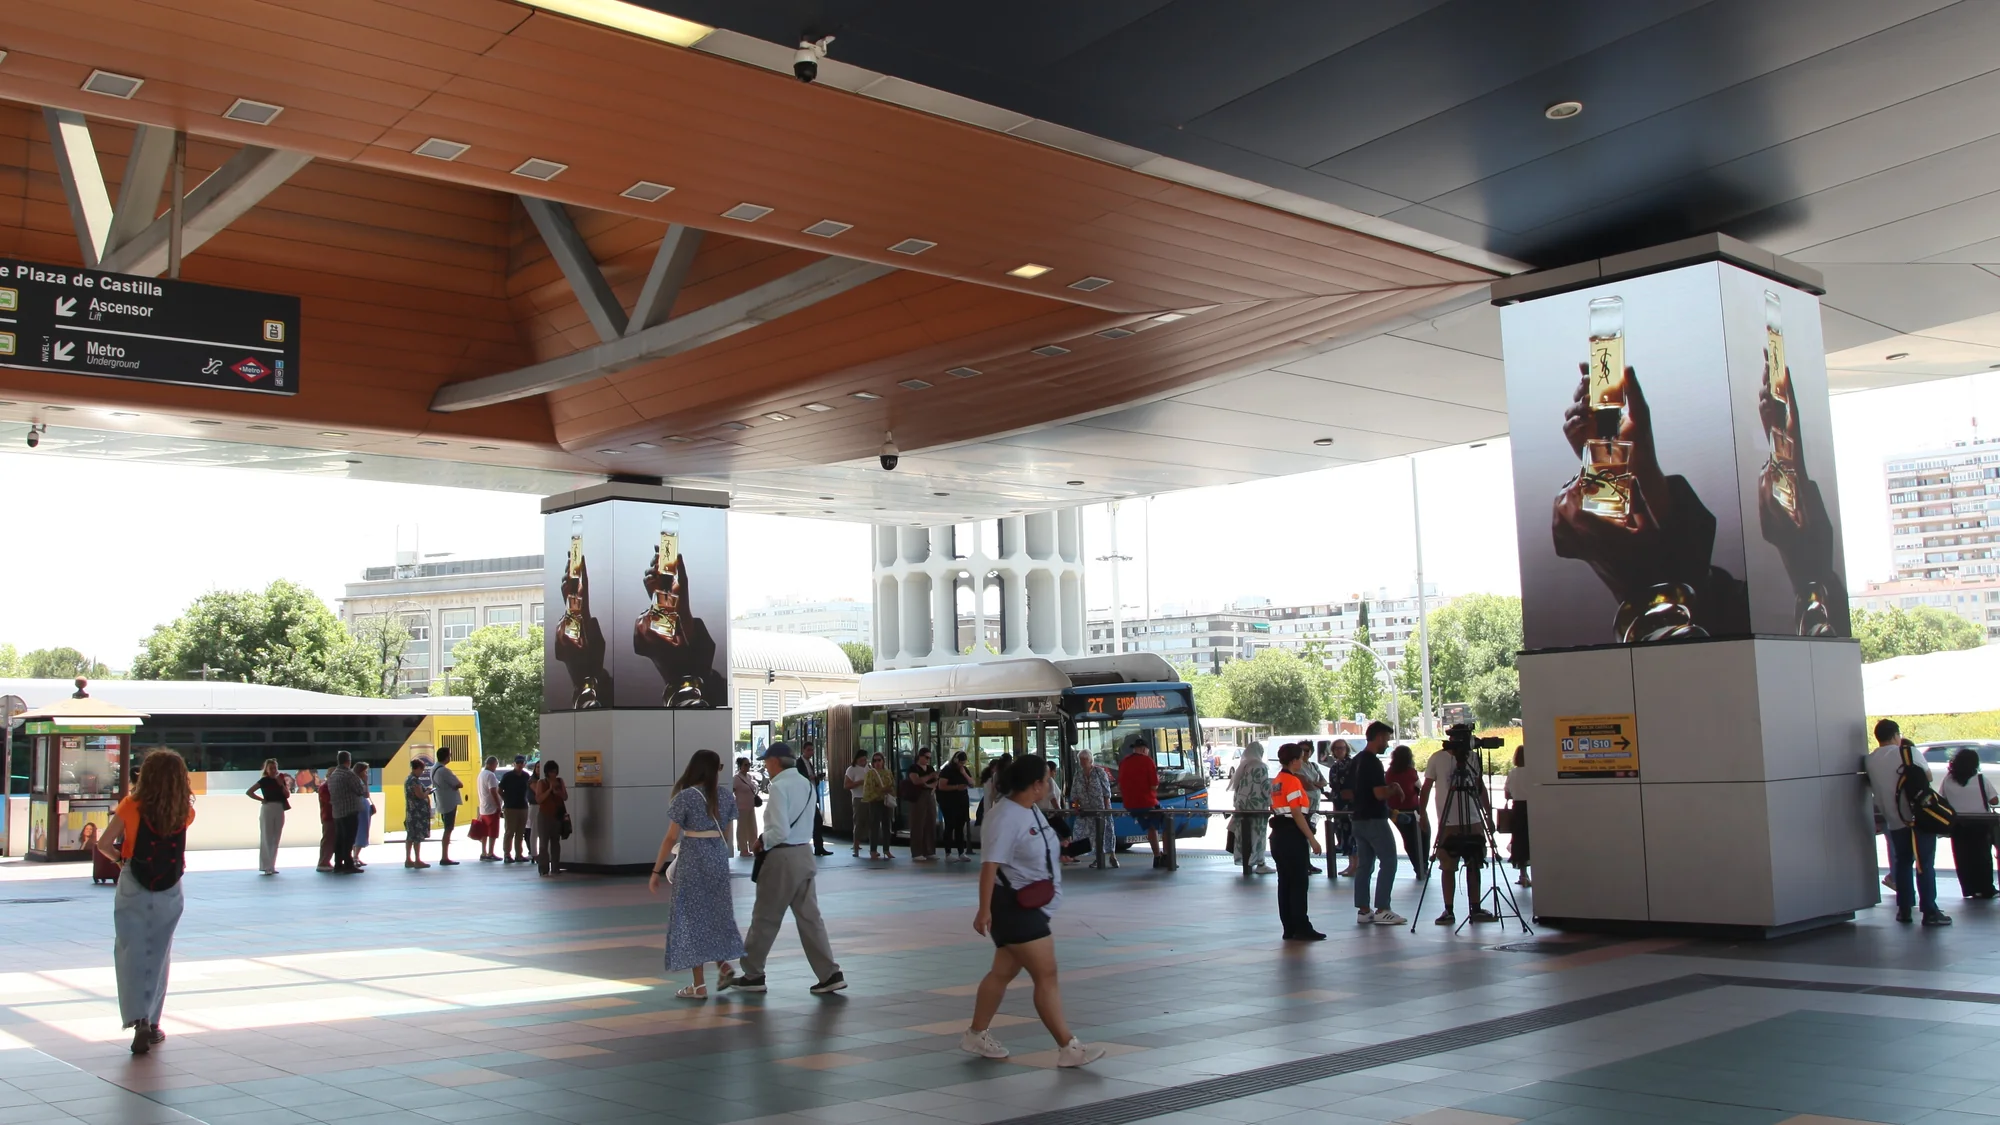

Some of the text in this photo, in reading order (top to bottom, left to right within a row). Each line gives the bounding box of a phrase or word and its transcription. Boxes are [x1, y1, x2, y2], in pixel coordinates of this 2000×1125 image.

[17, 265, 66, 285] Plaza
[73, 274, 94, 288] de
[100, 277, 163, 297] Castilla
[88, 312, 102, 321] Lift
[89, 298, 153, 318] Ascensor
[41, 343, 50, 362] NIVEL
[87, 341, 126, 358] Metro
[86, 356, 140, 370] Underground
[242, 366, 261, 374] Metro
[1087, 695, 1166, 713] 27 EMBAJADORES
[1562, 739, 1609, 751] 10 S10
